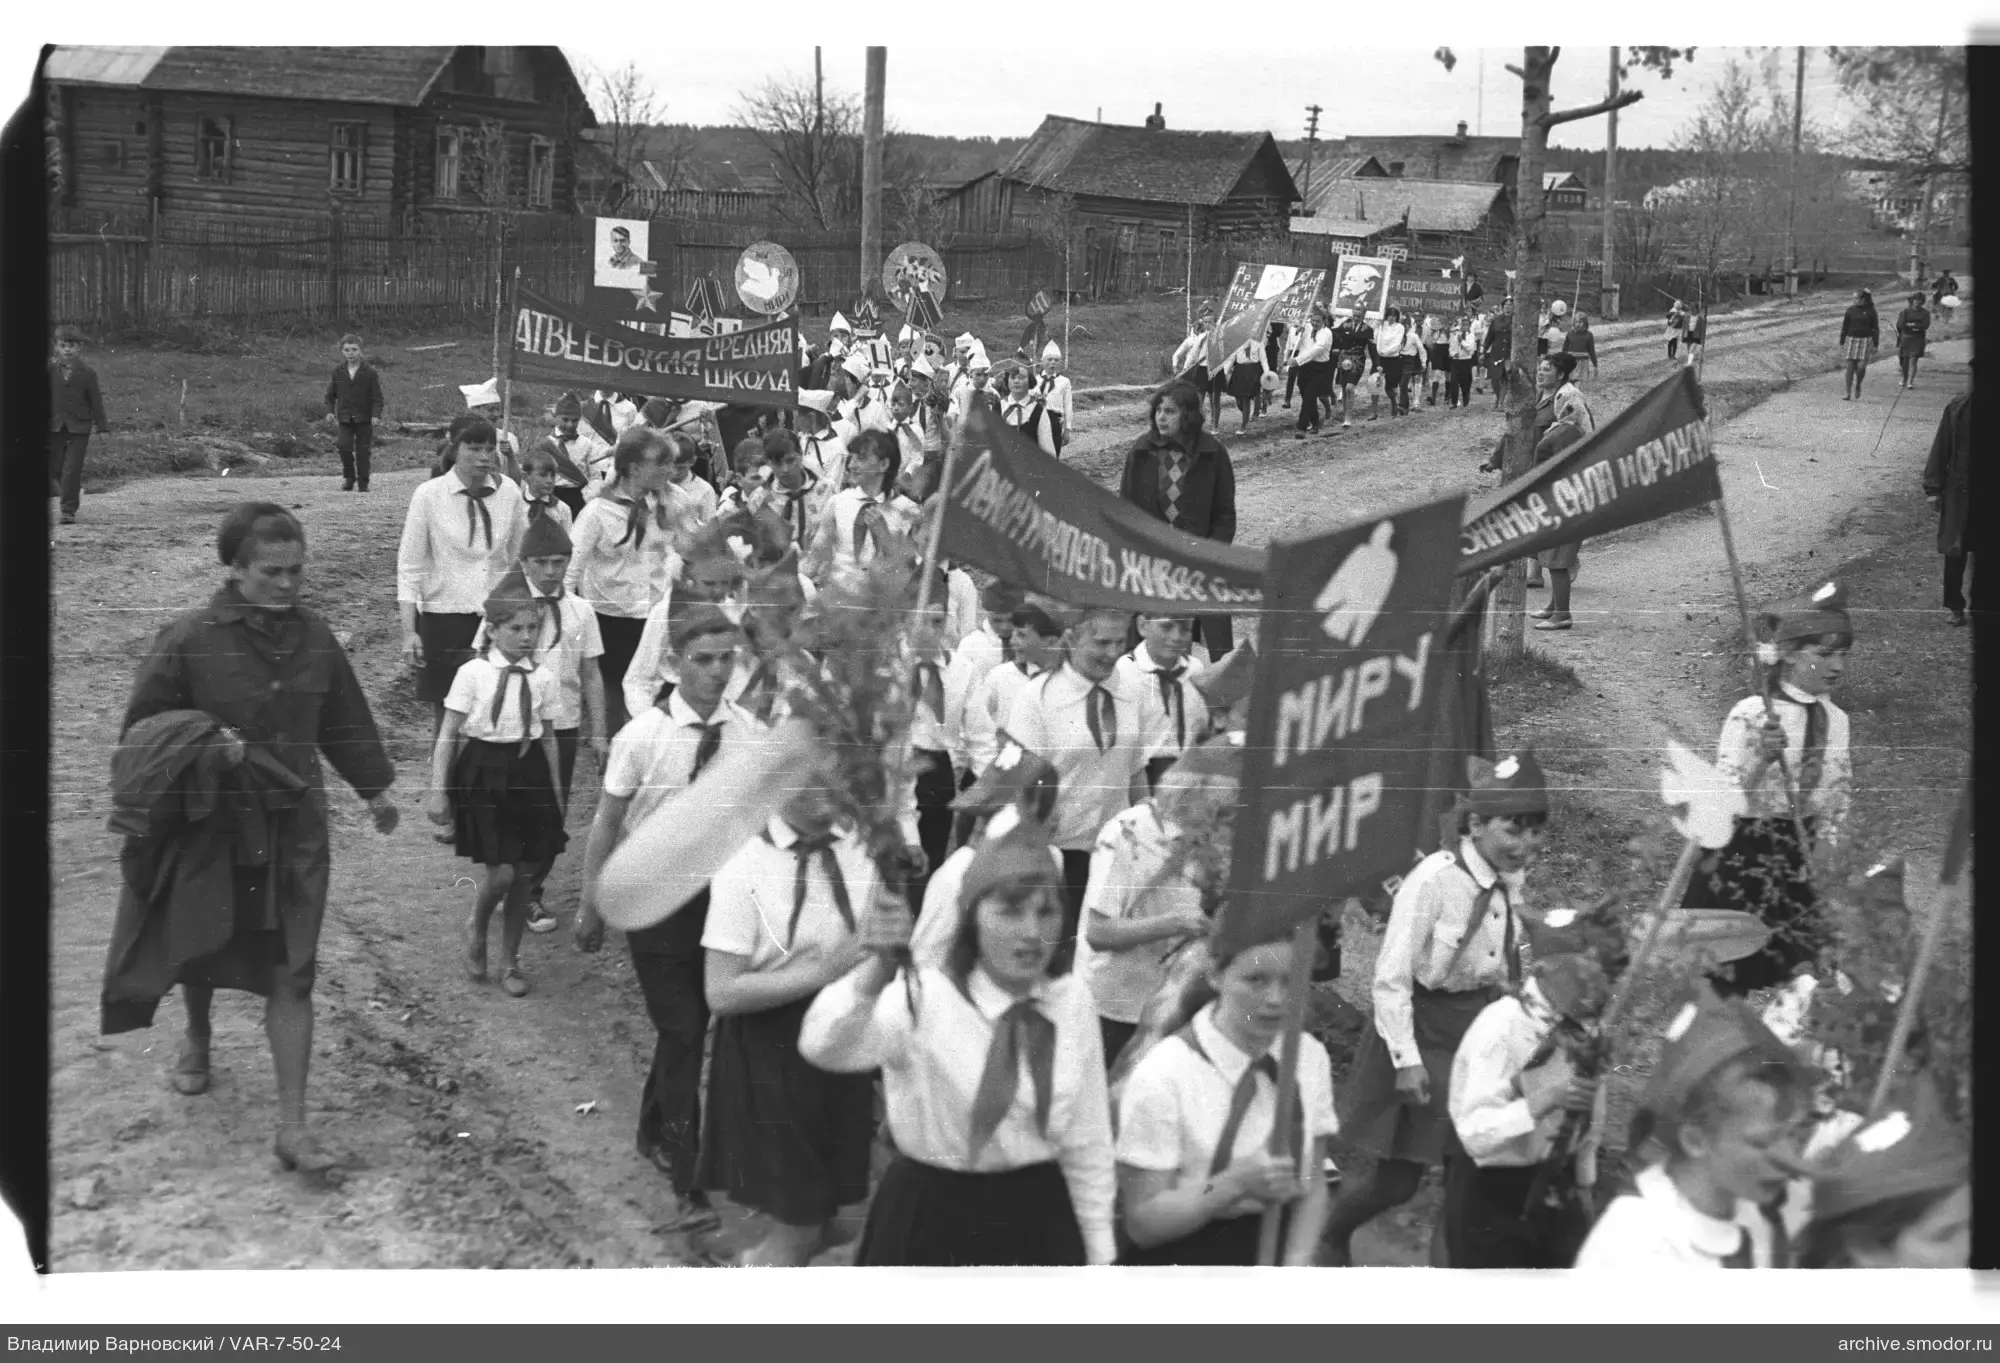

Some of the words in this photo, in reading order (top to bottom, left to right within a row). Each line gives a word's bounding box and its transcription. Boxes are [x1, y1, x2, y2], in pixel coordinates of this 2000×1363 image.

[705, 327, 793, 361] СРЕДНЯЯ
[705, 367, 792, 393] ШКОЛА
[1273, 632, 1433, 767] МИРУ
[1264, 772, 1384, 882] МИР
